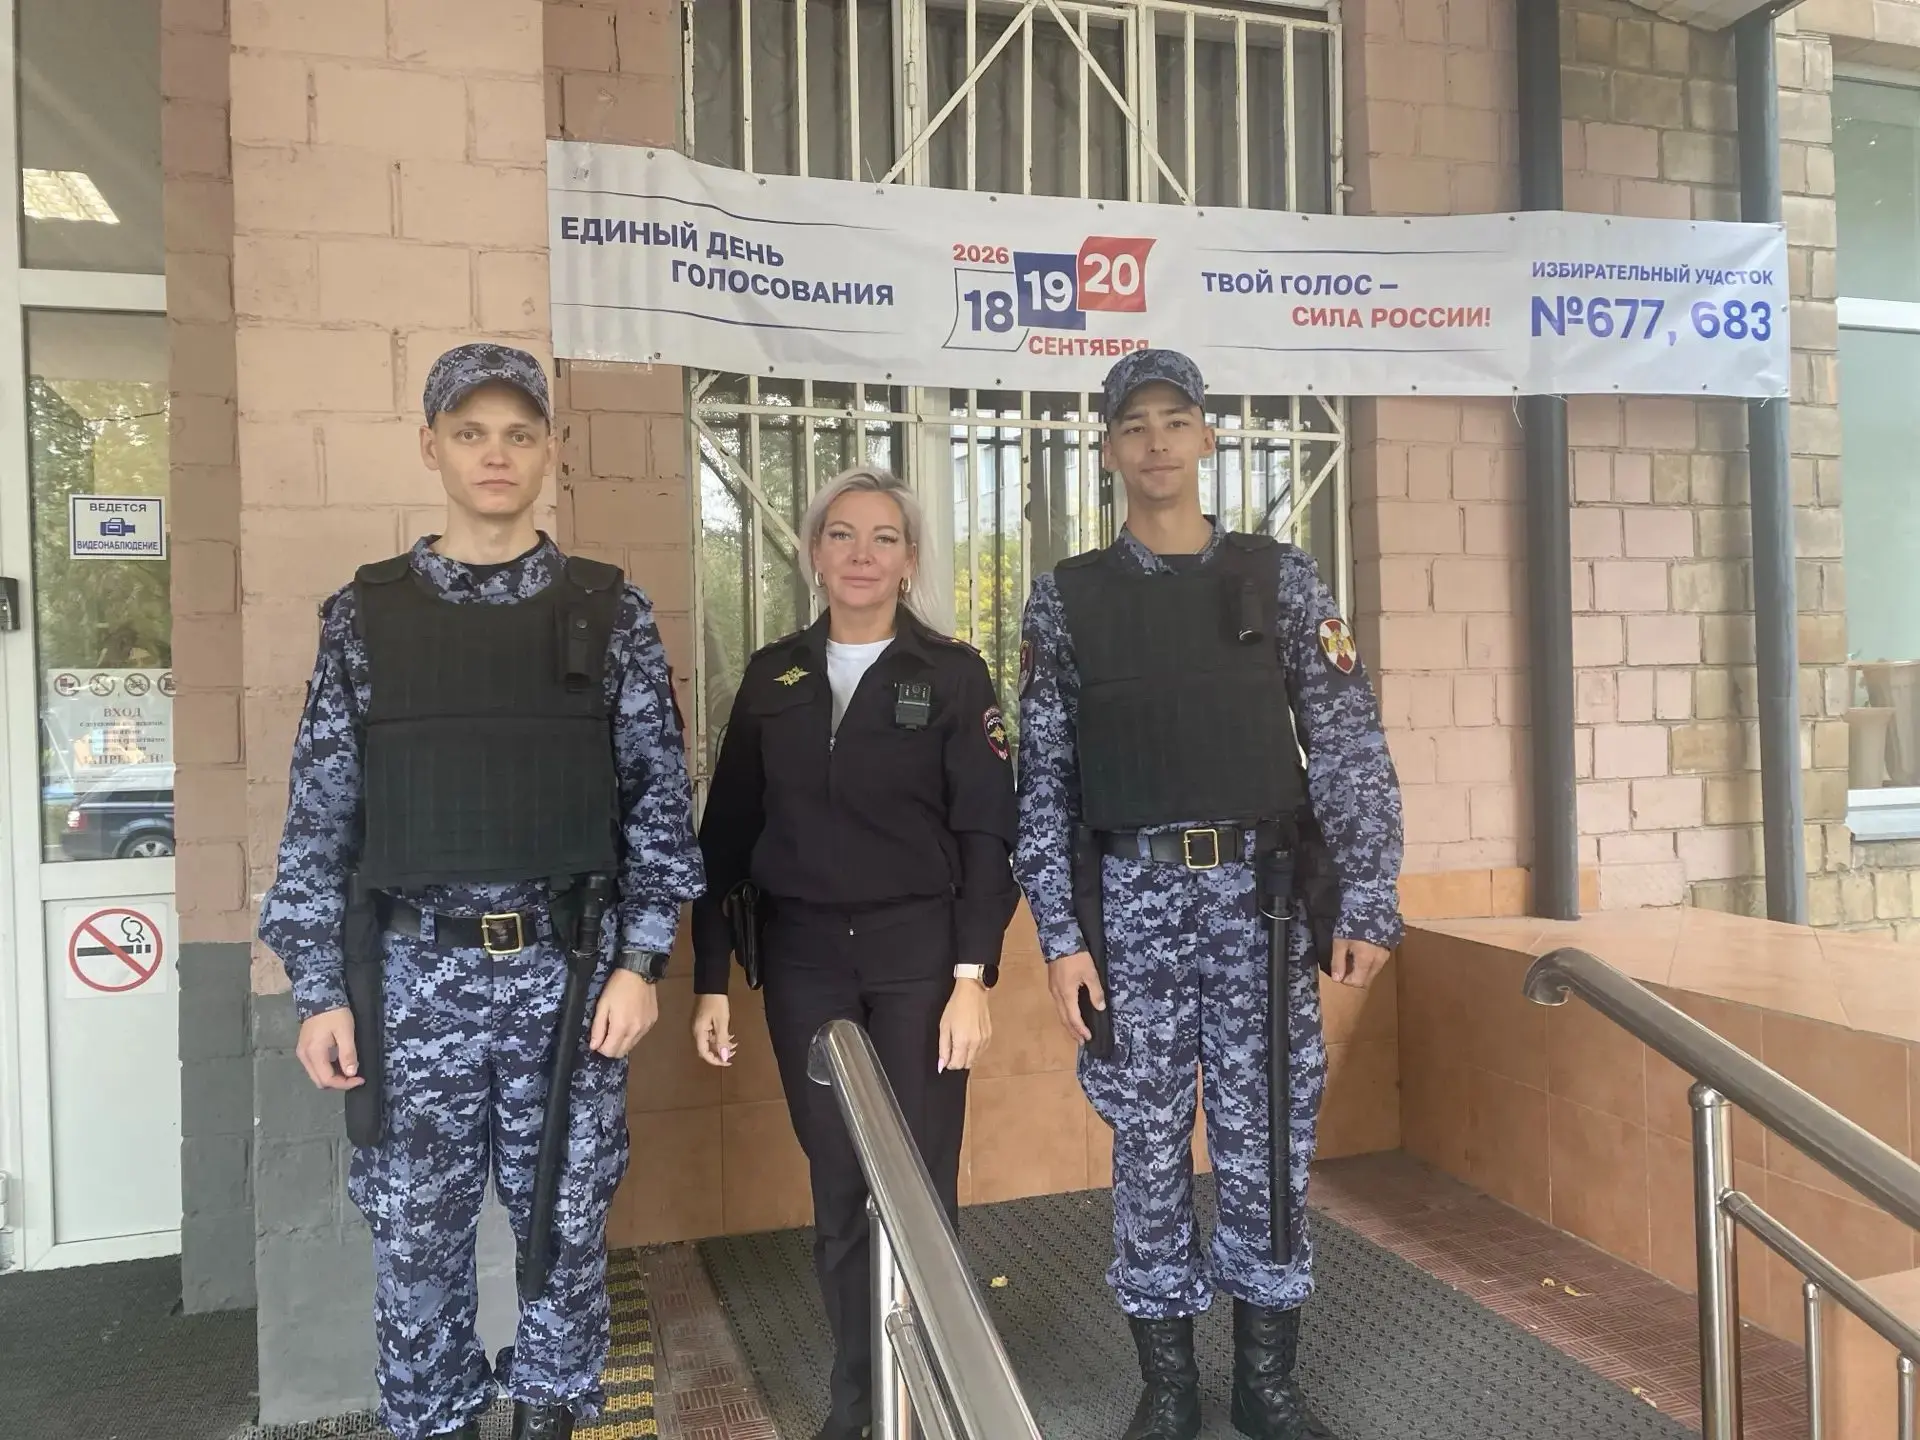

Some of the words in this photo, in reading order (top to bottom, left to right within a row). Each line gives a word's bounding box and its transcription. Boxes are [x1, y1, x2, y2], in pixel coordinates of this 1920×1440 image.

[561, 216, 698, 252] ЕДИНЫЙ
[706, 231, 785, 267] ДЕНЬ
[953, 243, 1010, 265] 2026
[672, 260, 894, 306] ГОЛОСОВАНИЯ
[1201, 269, 1273, 294] ТВОЙ
[1281, 274, 1373, 296] ГОЛОС
[1532, 261, 1690, 284] ИЗБИРАТЕЛЬНЫЙ
[1695, 269, 1773, 286] УЧАСТОК
[964, 289, 1014, 333] 18
[1023, 270, 1073, 312] 19
[1083, 253, 1140, 296] 20
[1292, 306, 1364, 328] СИЛА
[1371, 307, 1491, 328] РОССИИ!
[1531, 295, 1677, 346] №677,
[1691, 299, 1771, 341] 683
[89, 503, 147, 512] ВЕДЕТСЯ
[77, 540, 159, 551] ВИДЕОНАБЛЮДЕНИЕ
[104, 708, 142, 718] ВХОД
